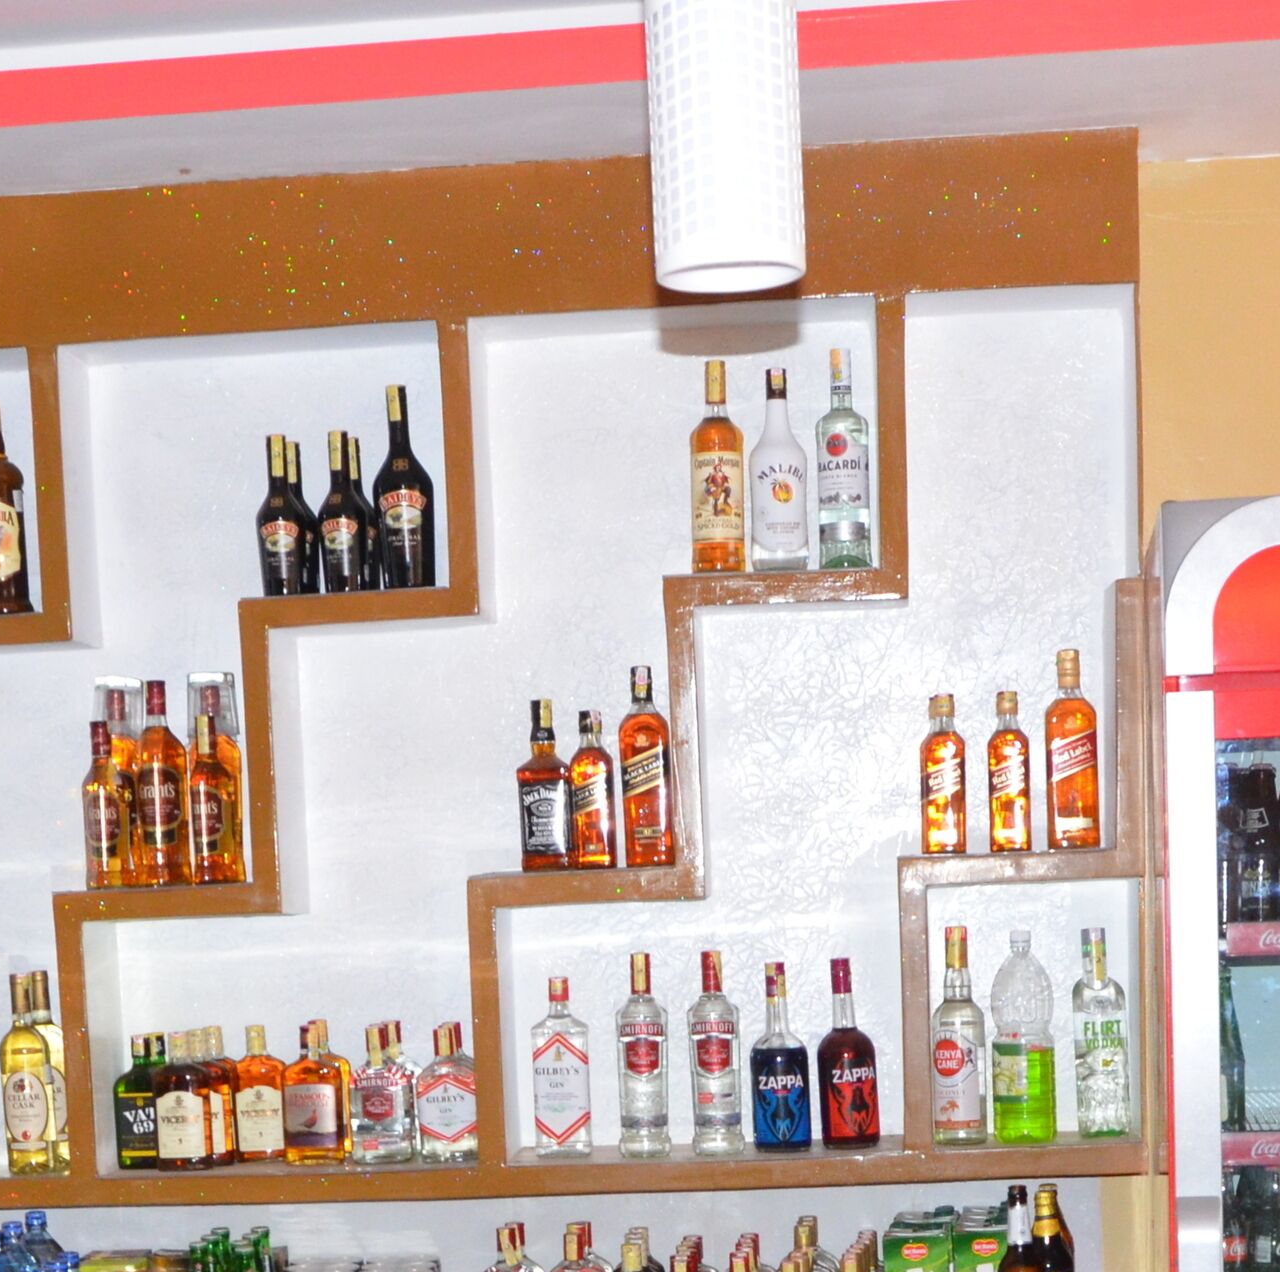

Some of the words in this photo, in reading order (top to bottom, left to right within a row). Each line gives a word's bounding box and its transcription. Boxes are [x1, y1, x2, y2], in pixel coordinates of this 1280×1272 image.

[757, 463, 805, 483] MALIBU
[1084, 1020, 1122, 1037] FLIRT
[1084, 1037, 1125, 1050] VODKA
[935, 1049, 962, 1060] KENYA
[534, 1065, 580, 1076] GILBEY'S
[937, 1060, 960, 1069] CANE
[831, 1067, 876, 1083] ZAPPA
[758, 1075, 804, 1091] ZAPPA
[132, 1121, 155, 1134] 69
